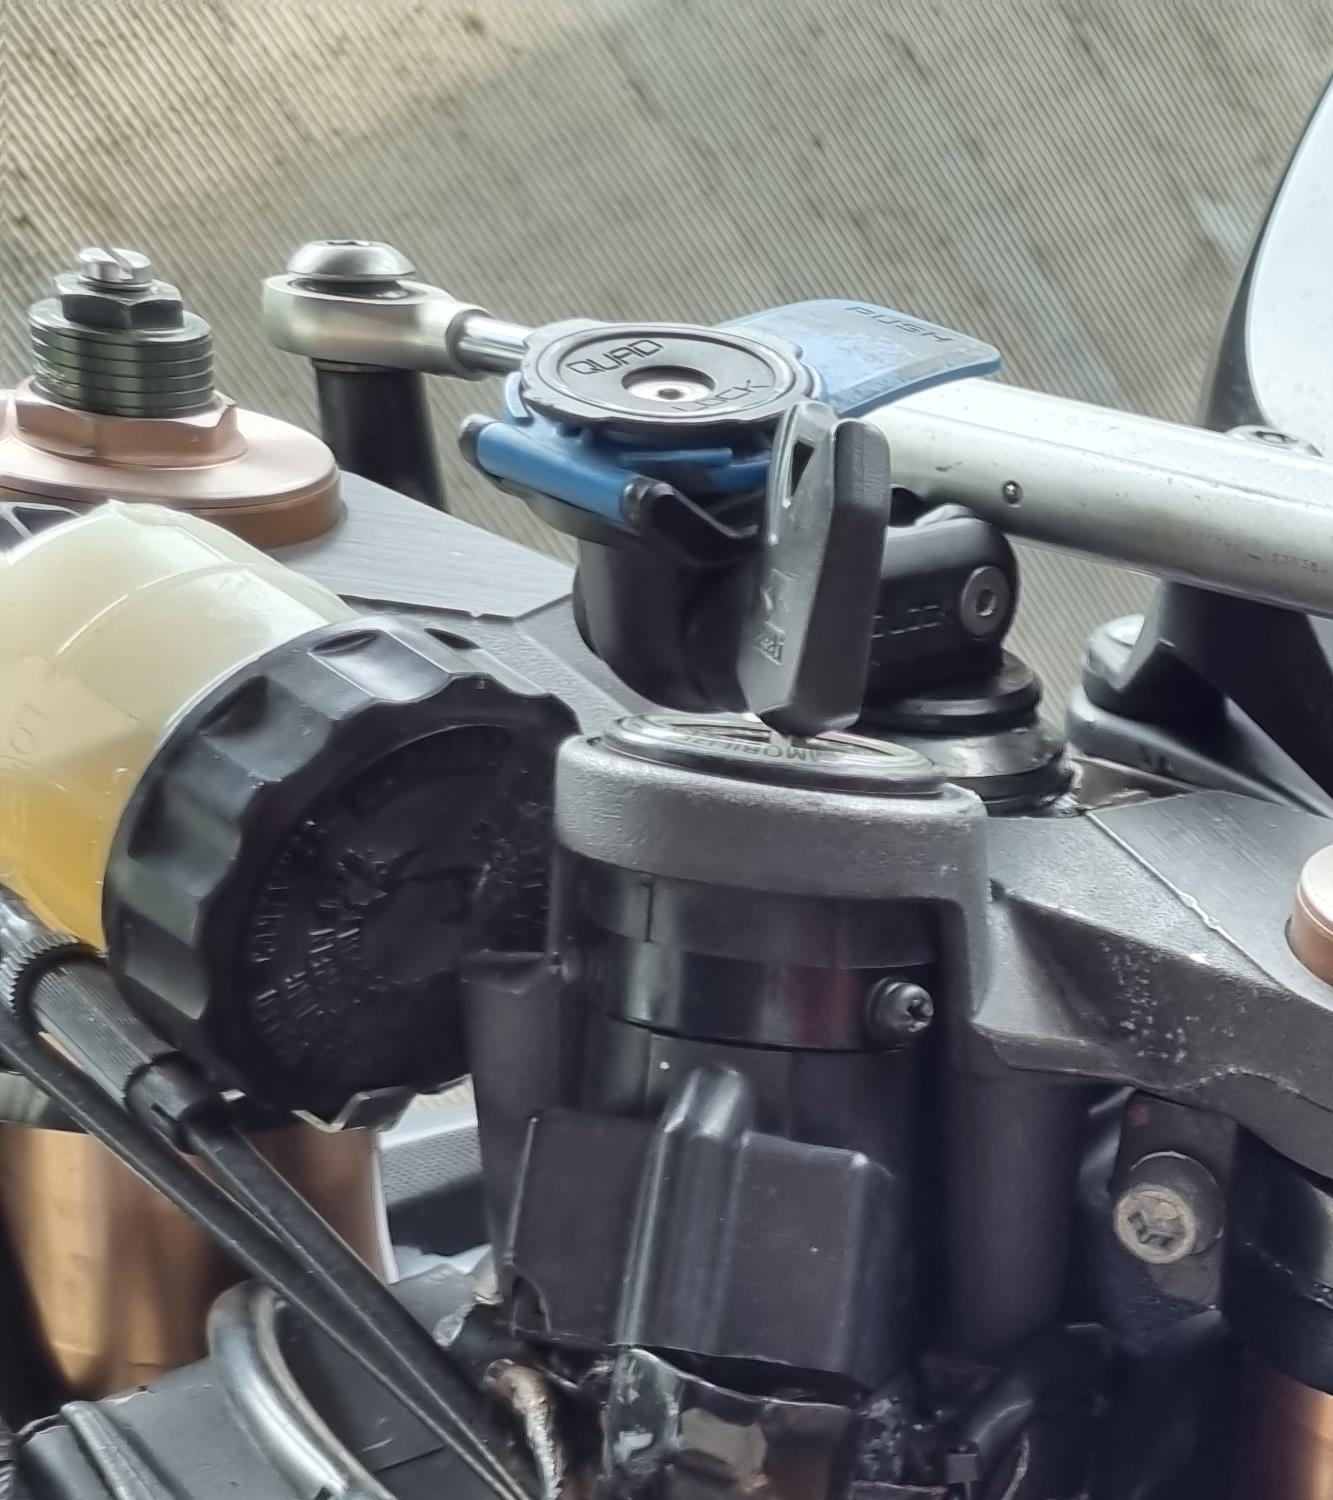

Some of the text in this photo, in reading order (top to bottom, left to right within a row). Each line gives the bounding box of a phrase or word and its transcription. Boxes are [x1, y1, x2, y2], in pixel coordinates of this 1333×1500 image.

[845, 305, 954, 344] PUSH
[565, 338, 665, 377] QUAD
[671, 379, 765, 413] LOCK
